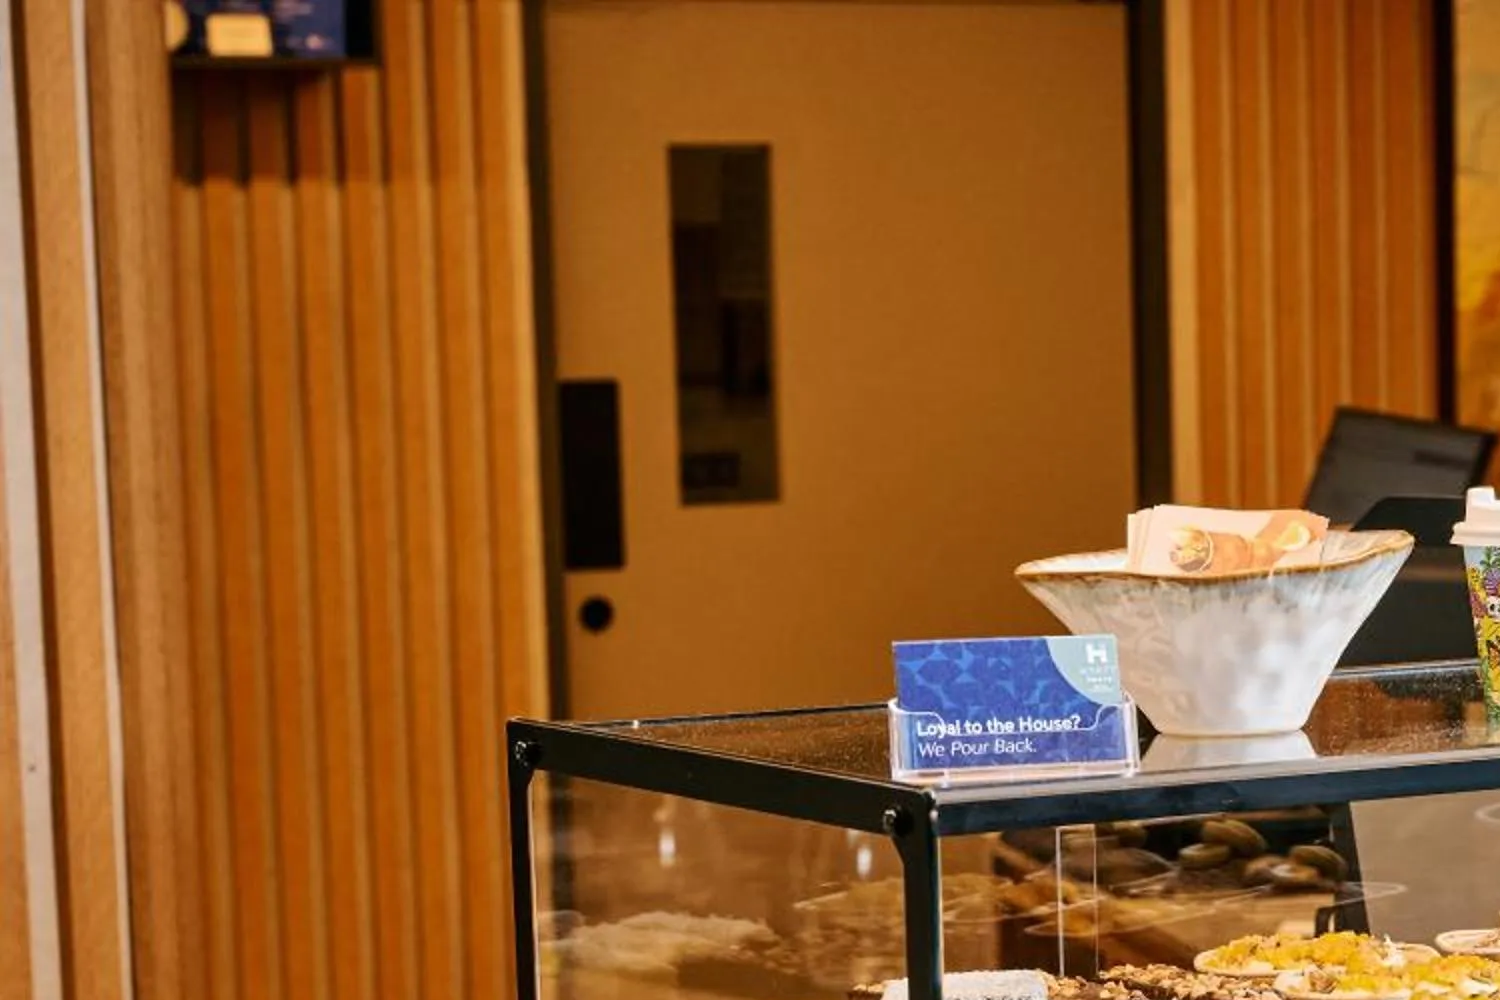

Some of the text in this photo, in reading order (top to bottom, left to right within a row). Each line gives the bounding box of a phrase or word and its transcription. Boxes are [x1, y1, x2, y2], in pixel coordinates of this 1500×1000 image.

[917, 715, 1081, 739] Loyal to the House?
[918, 737, 1037, 758] We Pour Back.
